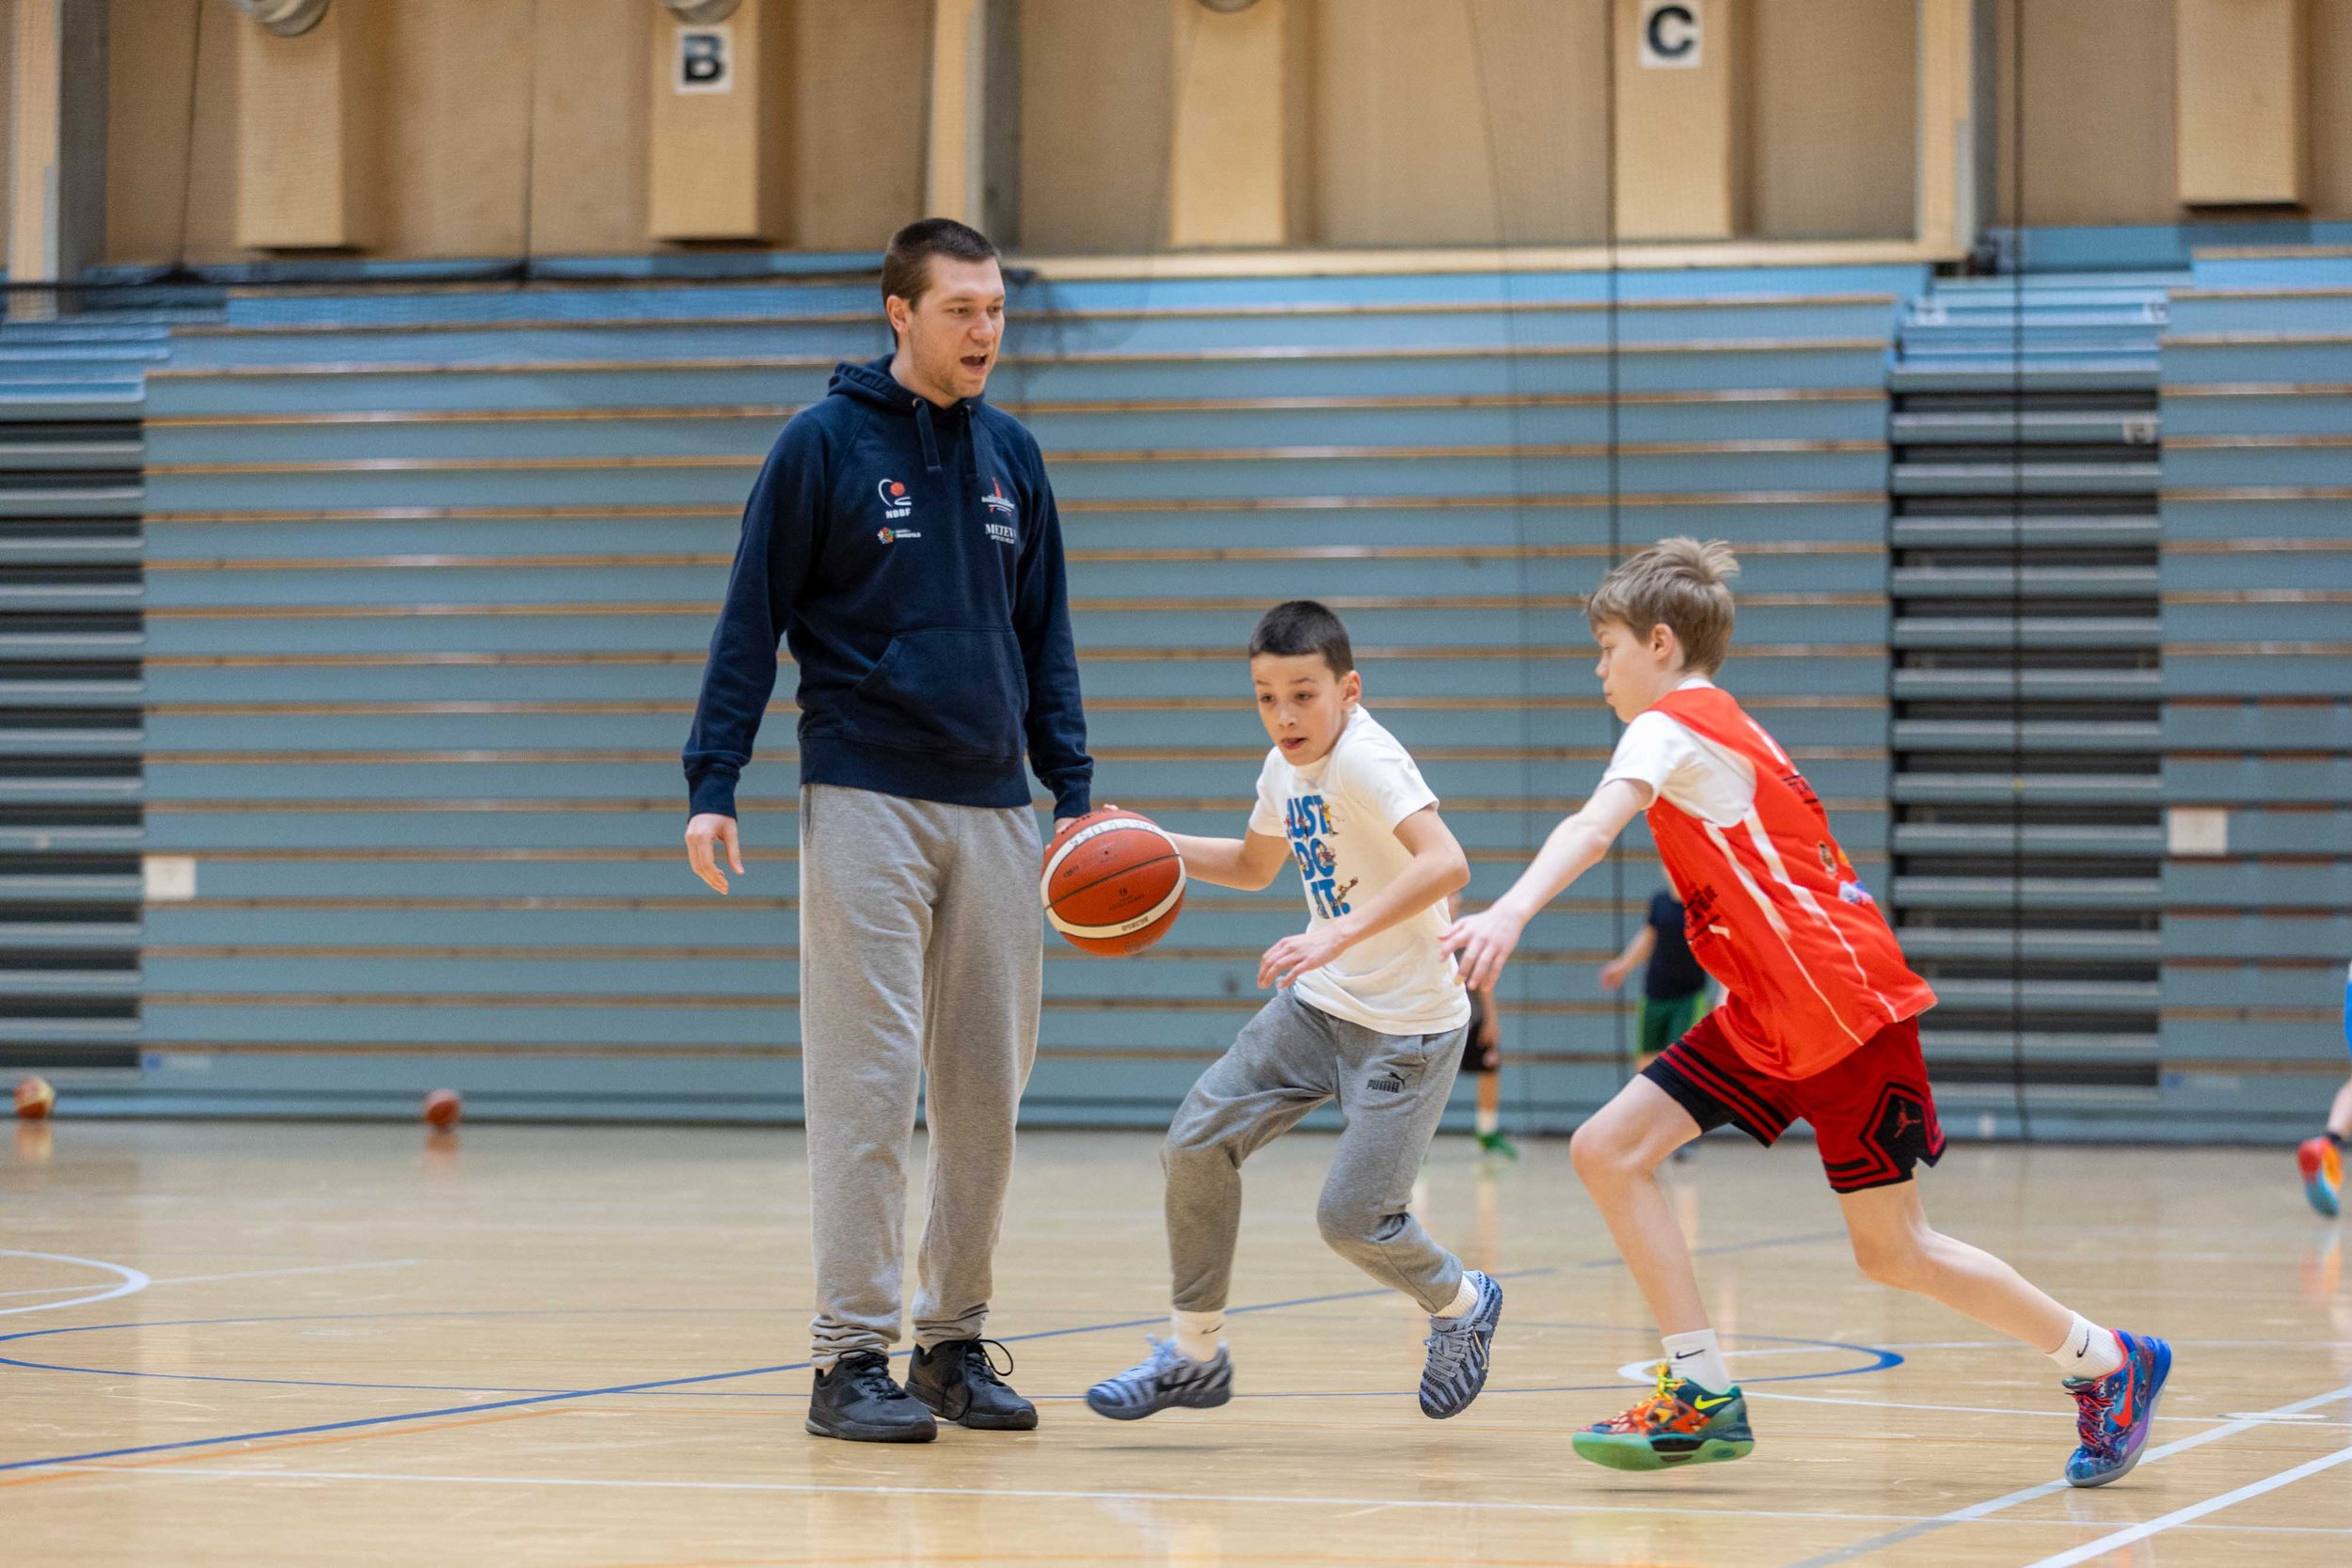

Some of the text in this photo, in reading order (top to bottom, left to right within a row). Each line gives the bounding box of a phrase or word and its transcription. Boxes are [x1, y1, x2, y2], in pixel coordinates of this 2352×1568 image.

[1647, 6, 1695, 57] C
[682, 35, 723, 84] B
[885, 507, 912, 519] NBBF
[1286, 795, 1328, 839] UST
[1294, 838, 1336, 880] DO
[1366, 1079, 1401, 1093] PUMA
